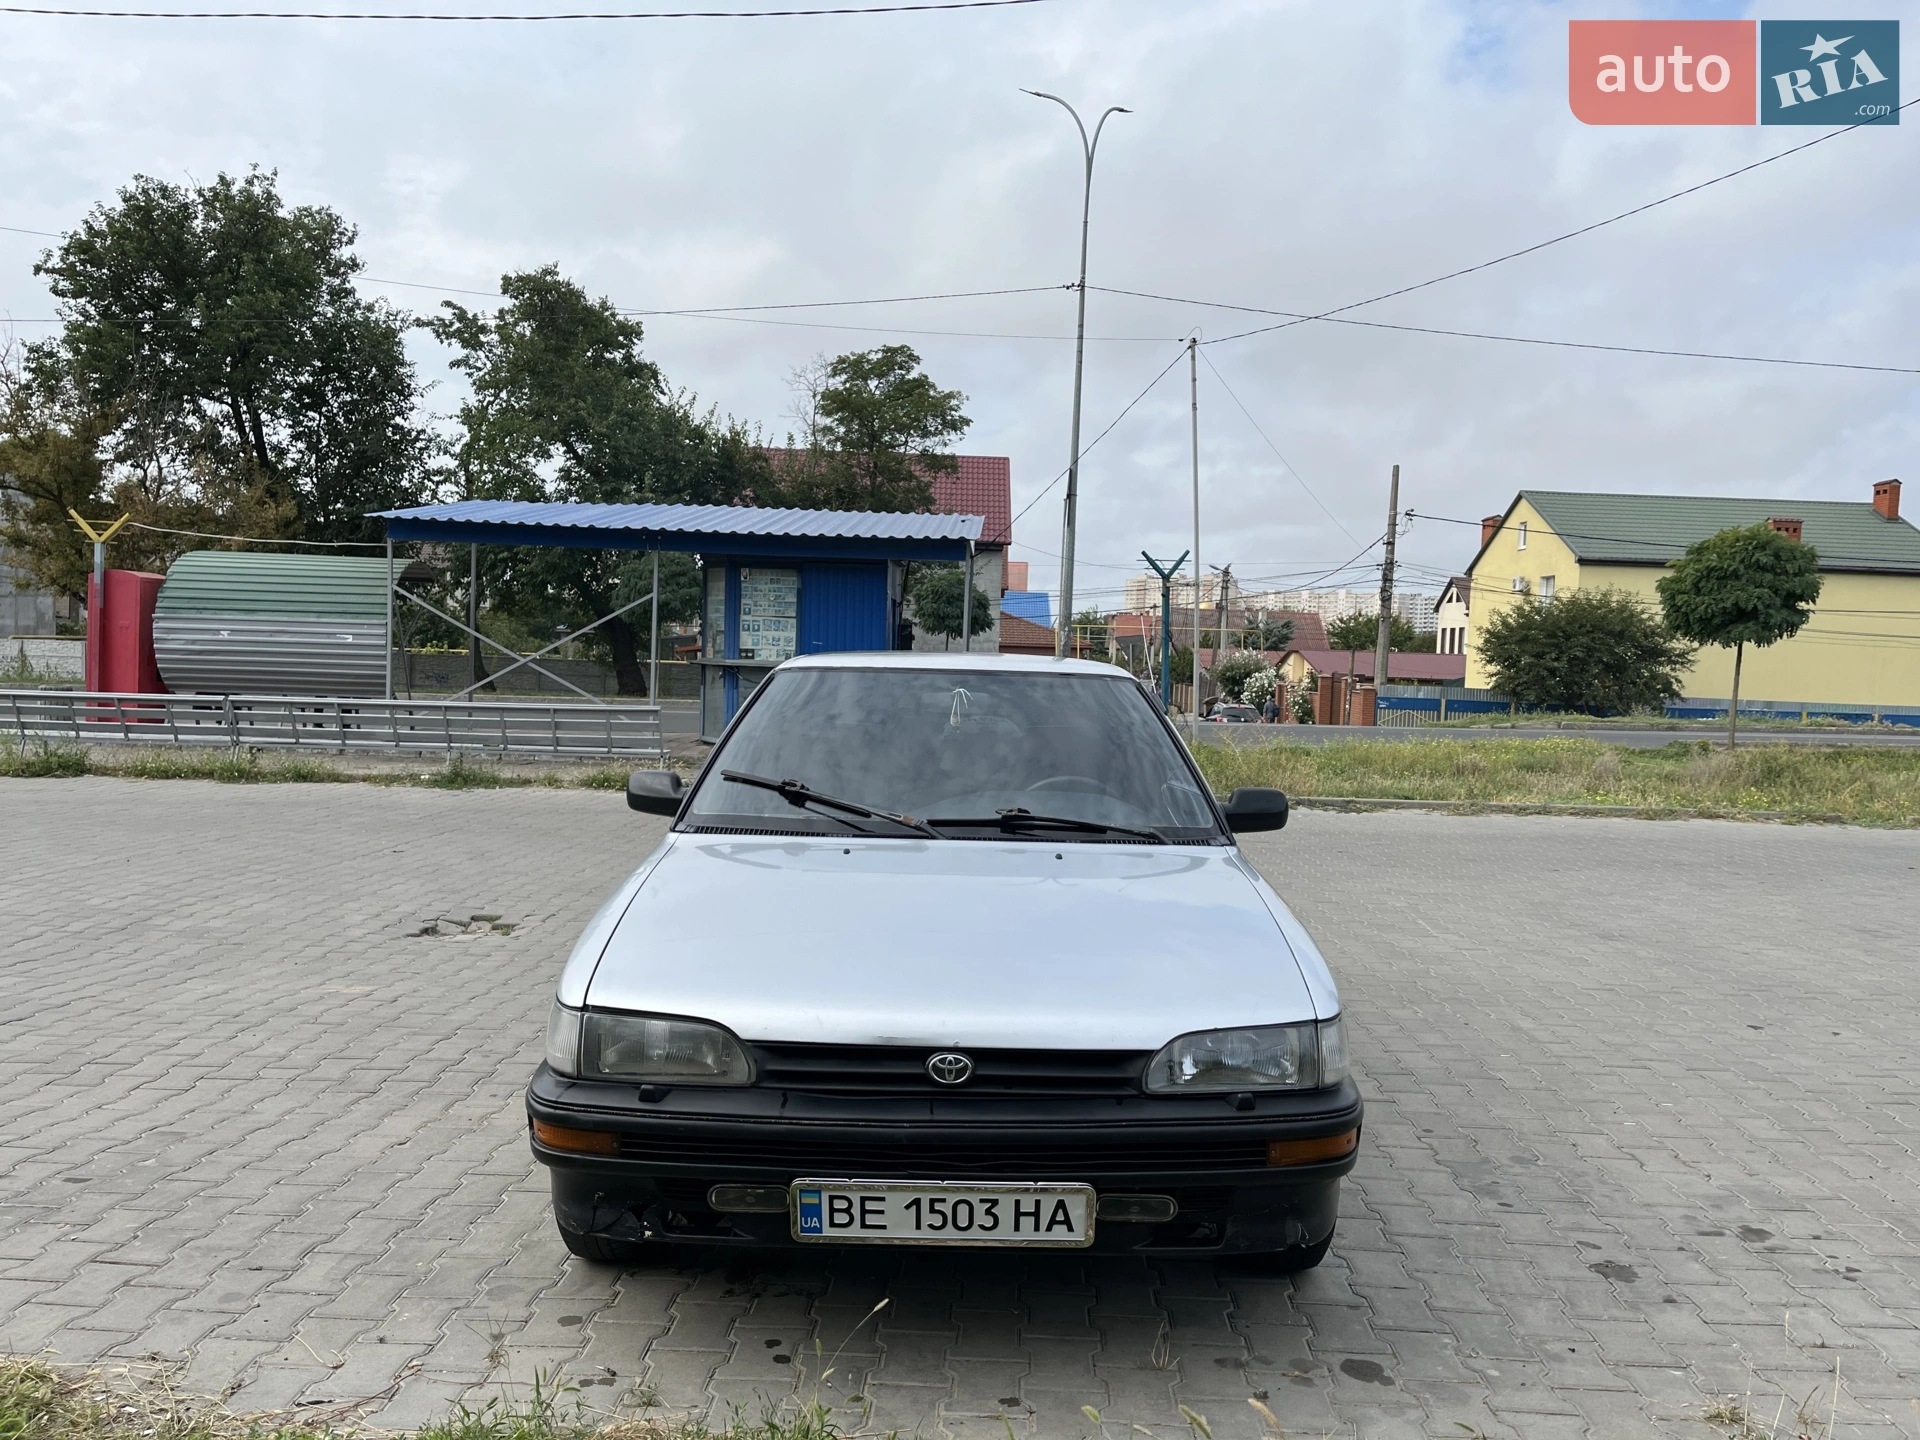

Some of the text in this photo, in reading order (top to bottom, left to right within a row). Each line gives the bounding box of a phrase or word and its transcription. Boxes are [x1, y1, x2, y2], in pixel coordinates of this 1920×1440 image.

[801, 1216, 821, 1229] UA
[828, 1194, 1075, 1233] BE 1503 HA
